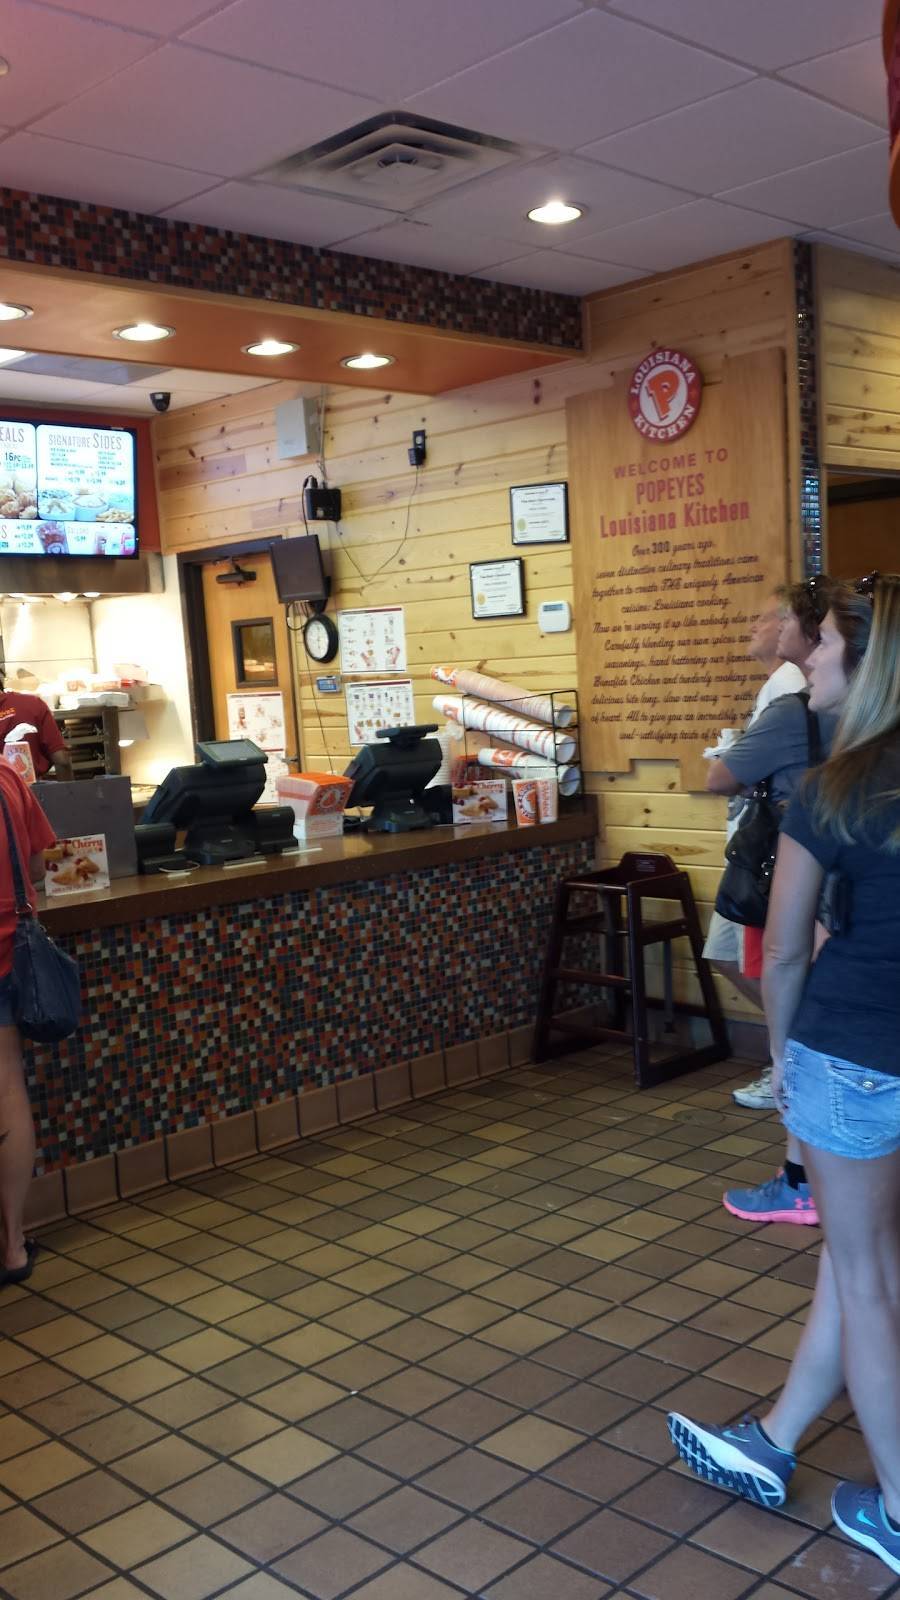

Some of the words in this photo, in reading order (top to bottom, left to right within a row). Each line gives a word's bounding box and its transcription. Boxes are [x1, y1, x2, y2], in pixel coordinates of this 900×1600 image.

[631, 351, 696, 394] LOUISIANA
[634, 403, 696, 439] KITCHEN
[93, 433, 122, 450] SIDES
[614, 453, 697, 479] WELCOME
[705, 448, 728, 464] TO
[636, 473, 705, 504] POPEYES
[601, 510, 676, 538] Louisiana
[684, 499, 749, 527] Kitchen
[632, 544, 650, 556] Over
[652, 541, 669, 554] 300
[672, 543, 694, 556] years
[617, 565, 655, 577] distinctive
[658, 560, 690, 573] culinary
[693, 556, 734, 568] traditions
[736, 555, 758, 564] came
[592, 587, 624, 601] together
[625, 585, 632, 594] to
[635, 583, 657, 593] create
[661, 577, 682, 591] THE
[684, 574, 717, 591] uniquely
[722, 572, 763, 585] American
[653, 598, 694, 610] Louisiana
[593, 622, 609, 633] Now
[634, 621, 661, 634] serving
[663, 619, 670, 628] it
[671, 620, 681, 632] up
[683, 615, 697, 627] like
[700, 613, 728, 629] nobody
[731, 611, 747, 623] else
[604, 638, 639, 653] Carefully
[642, 637, 673, 651] blending
[712, 634, 735, 647] spices
[649, 655, 670, 667] hand
[672, 655, 707, 668] battering
[710, 655, 725, 664] our
[593, 675, 627, 689] Bonafide
[630, 674, 660, 686] Chicken
[663, 673, 678, 684] and
[679, 671, 711, 687] tenderly
[715, 669, 747, 686] cooking
[592, 693, 624, 705] delicious
[626, 692, 639, 703] bite
[663, 690, 681, 703] slow
[682, 691, 699, 702] and
[701, 694, 718, 706] easy
[591, 712, 600, 724] of
[626, 710, 640, 721] All
[641, 712, 649, 720] to
[650, 712, 667, 725] give
[667, 713, 683, 725] you
[697, 708, 737, 725] incredibly
[680, 729, 699, 739] taste
[701, 727, 711, 741] of
[72, 839, 103, 849] Cherry
